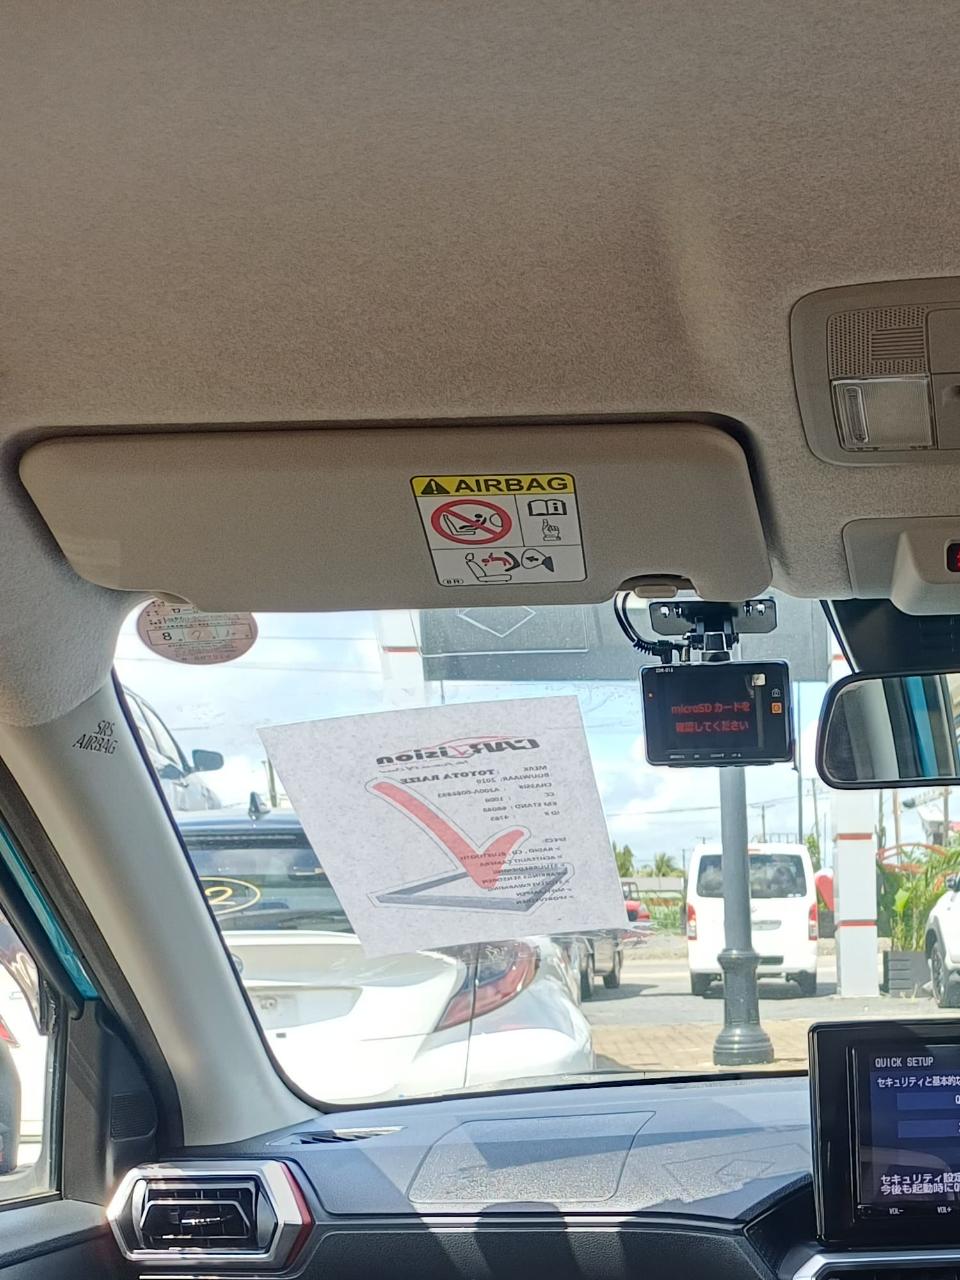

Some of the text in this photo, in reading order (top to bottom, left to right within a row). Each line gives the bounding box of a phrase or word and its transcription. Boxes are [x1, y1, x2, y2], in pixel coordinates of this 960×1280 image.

[454, 477, 568, 493] AIRBAG
[672, 703, 712, 714] microSD
[94, 720, 115, 737] SRS
[72, 733, 119, 754] AIRBAG
[875, 1056, 934, 1068] QUICK SETUP
